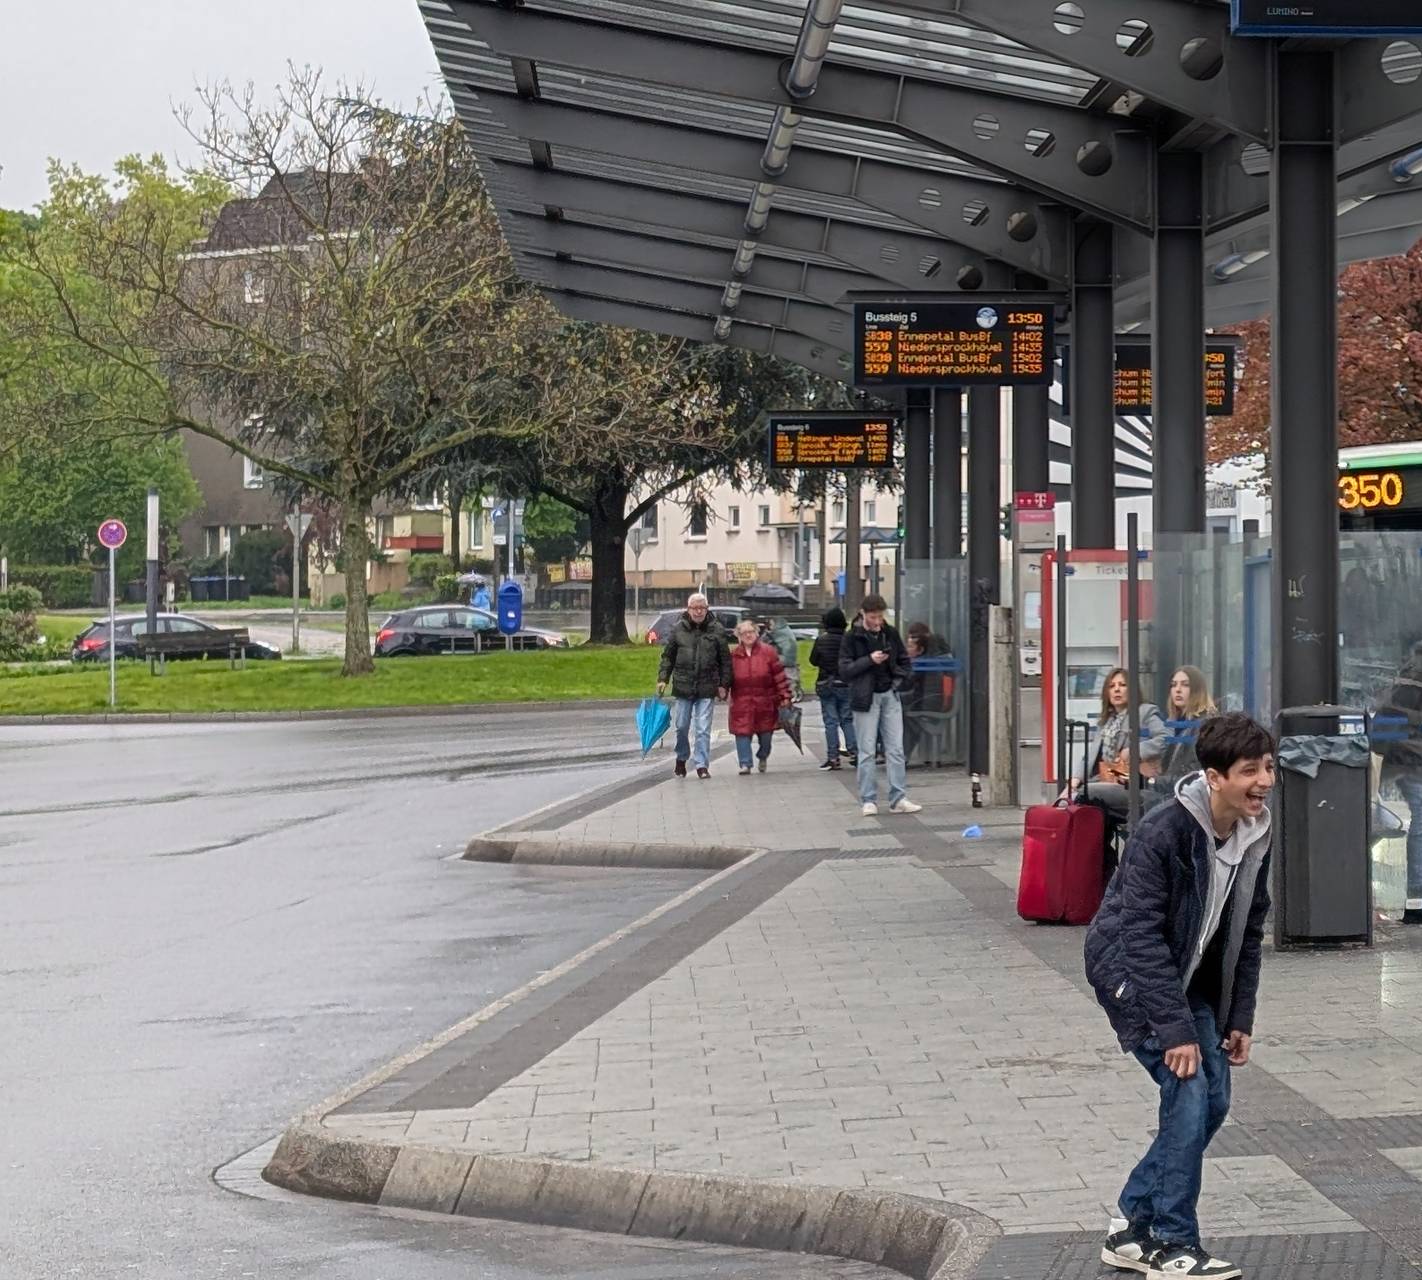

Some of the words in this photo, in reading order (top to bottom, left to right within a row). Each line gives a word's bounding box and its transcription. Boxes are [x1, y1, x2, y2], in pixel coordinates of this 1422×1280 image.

[865, 311, 908, 324] Bussteig
[910, 312, 918, 322] 5
[1007, 313, 1043, 324] 13:50
[898, 331, 954, 342] Ennepetal
[959, 331, 992, 343] BusBf
[1012, 331, 1043, 341] 14:02
[864, 342, 889, 352] 559
[898, 342, 1003, 354] Niedersprockhövel
[1012, 342, 1043, 352] 14:35
[898, 352, 954, 364] Ennepetal
[959, 352, 992, 364] BusBf
[1012, 353, 1043, 363] 15:02
[864, 363, 889, 374] 559
[898, 363, 1003, 376] Niedersprockhövel
[1012, 363, 1043, 374] 15:35
[1338, 473, 1402, 509] 350
